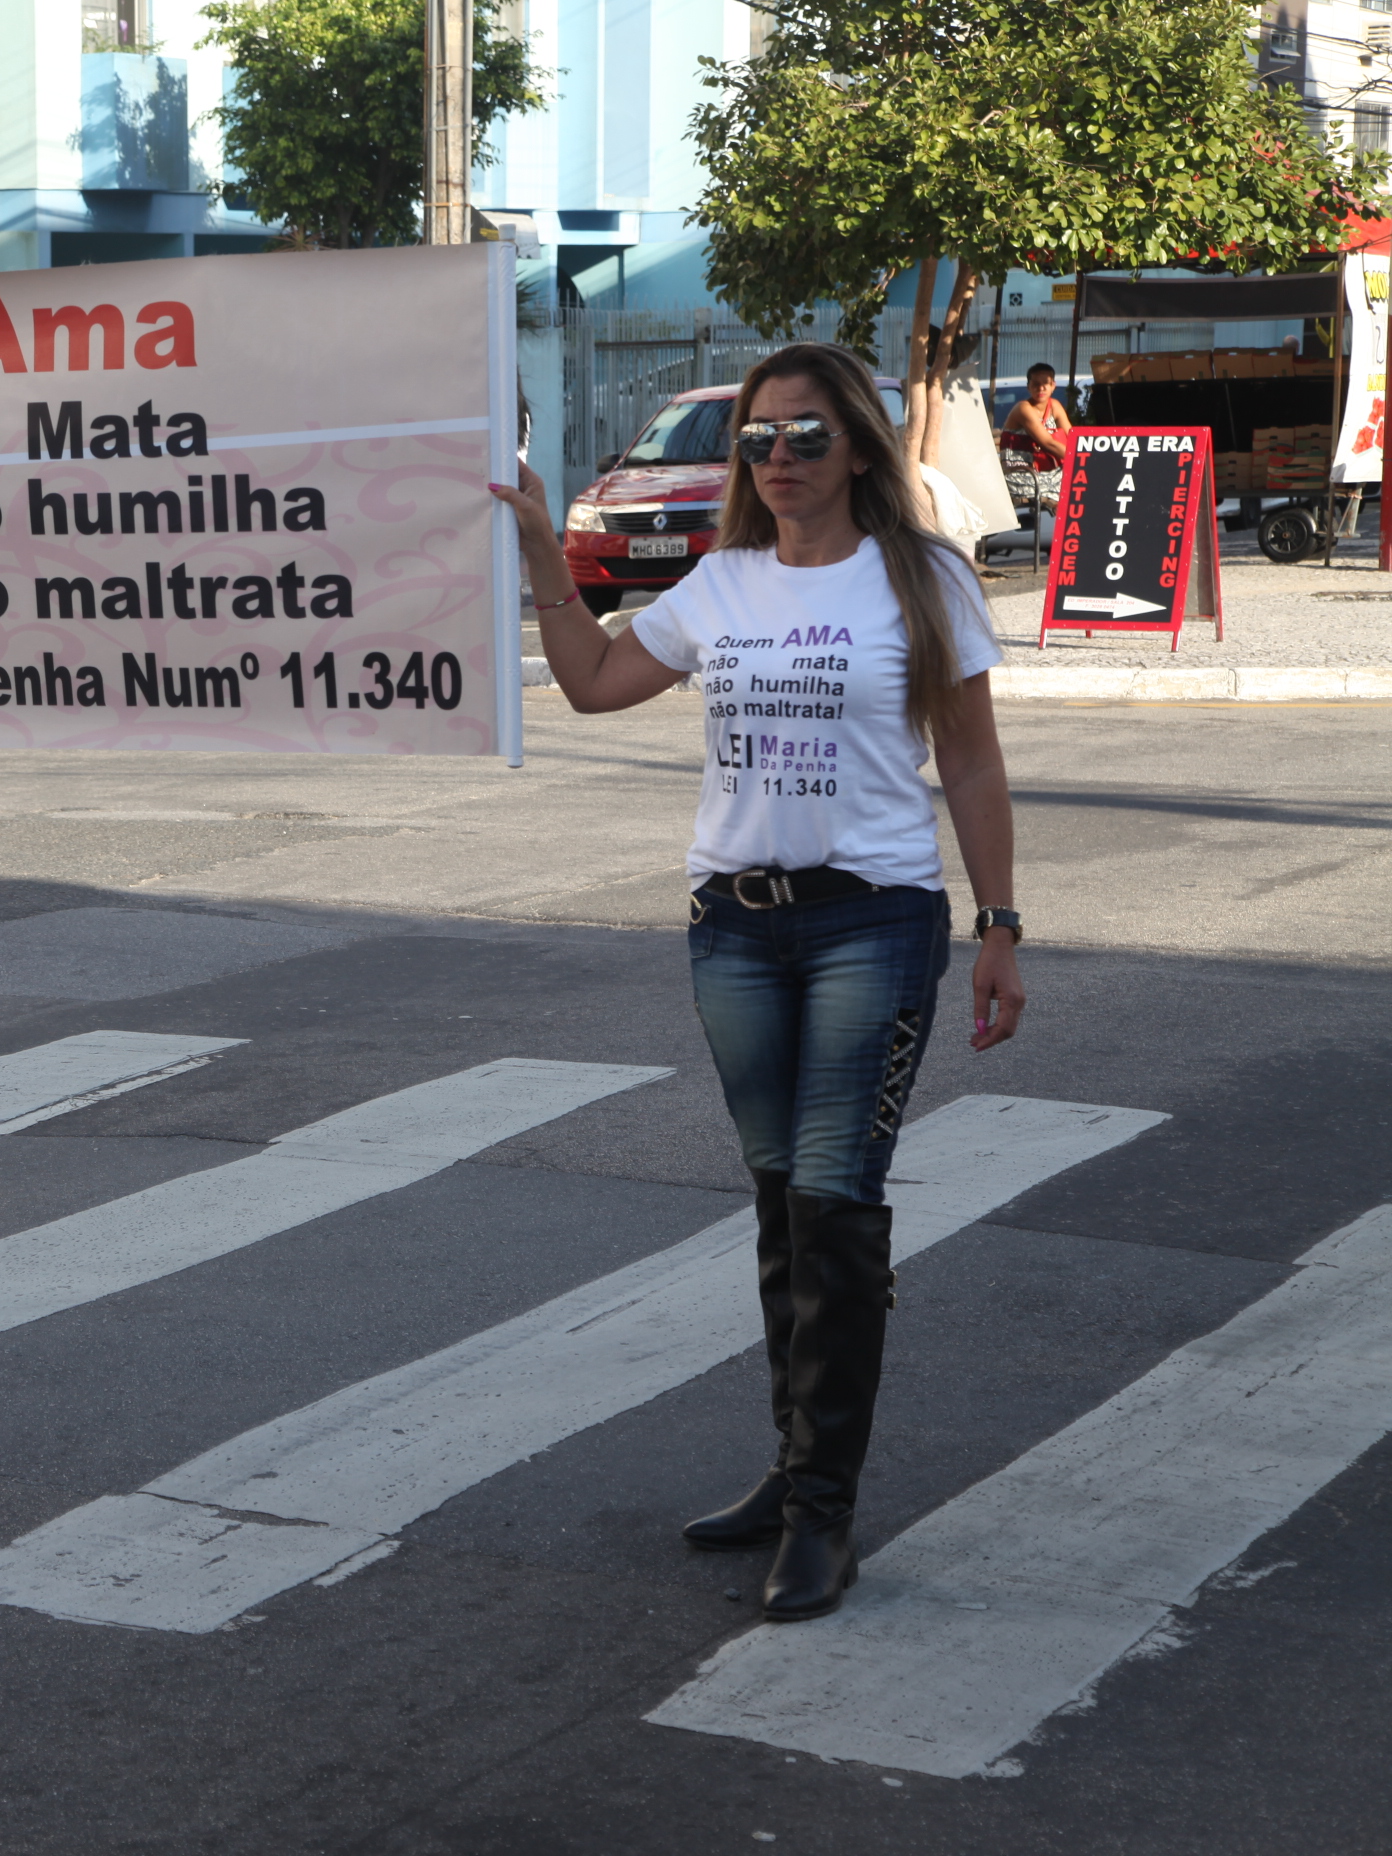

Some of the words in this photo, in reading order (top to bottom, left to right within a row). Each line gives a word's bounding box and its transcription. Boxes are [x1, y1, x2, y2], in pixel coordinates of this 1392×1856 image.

[26, 399, 209, 461] Mata
[1076, 435, 1140, 452] NOVA
[1147, 435, 1194, 452] ERA
[27, 473, 327, 536] humilha
[1058, 452, 1090, 586] TATUAGEM
[1105, 452, 1139, 581] TATTOO
[1159, 452, 1192, 588] PIERCING
[655, 544, 684, 555] 6389
[35, 560, 354, 620] maltrata
[715, 635, 774, 649] Quem
[780, 625, 854, 649] AMA
[707, 654, 739, 673] não
[792, 654, 849, 672] mata
[121, 651, 260, 708] Numº
[280, 651, 463, 710] 11.340
[706, 676, 734, 696] não
[750, 674, 845, 697] humilha
[709, 700, 738, 719] não
[744, 699, 844, 720] maltrata!
[717, 733, 753, 769] LEI
[760, 735, 837, 758] Maria
[760, 758, 777, 770] Da
[783, 759, 837, 772] Penha
[722, 774, 738, 795] LEI
[763, 777, 837, 797] 11.340
